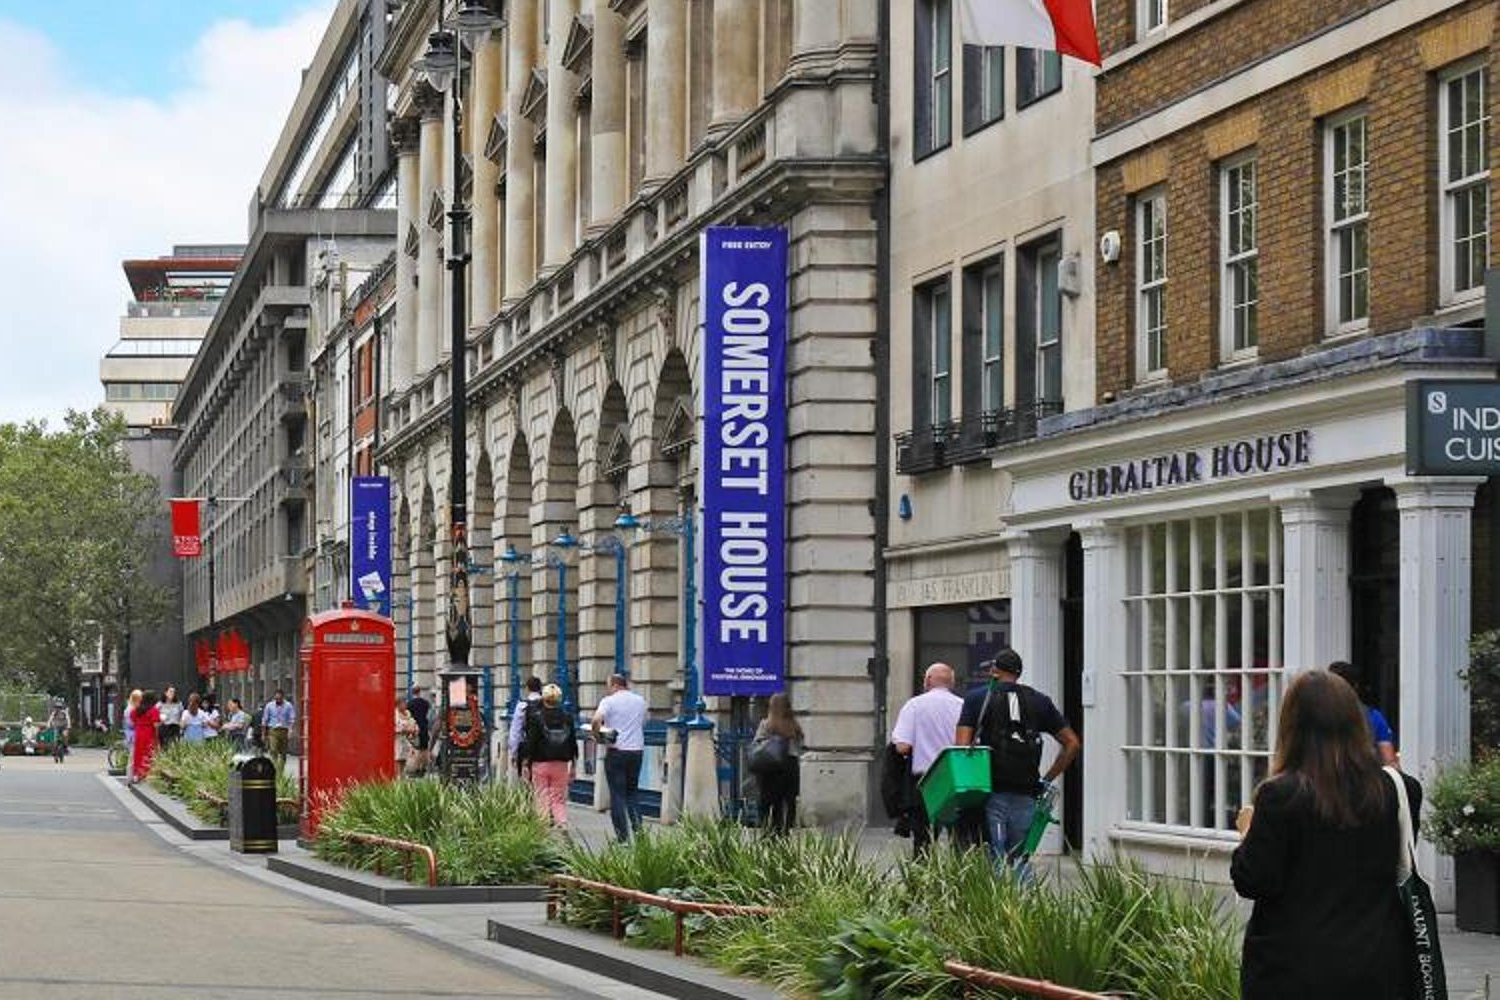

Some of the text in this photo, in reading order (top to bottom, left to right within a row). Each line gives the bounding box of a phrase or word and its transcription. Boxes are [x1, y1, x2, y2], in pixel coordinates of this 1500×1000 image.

[1430, 393, 1445, 412] S
[720, 282, 770, 643] SOMERSET HOUSE
[1069, 430, 1311, 501] GIBRALTAR HOUSE
